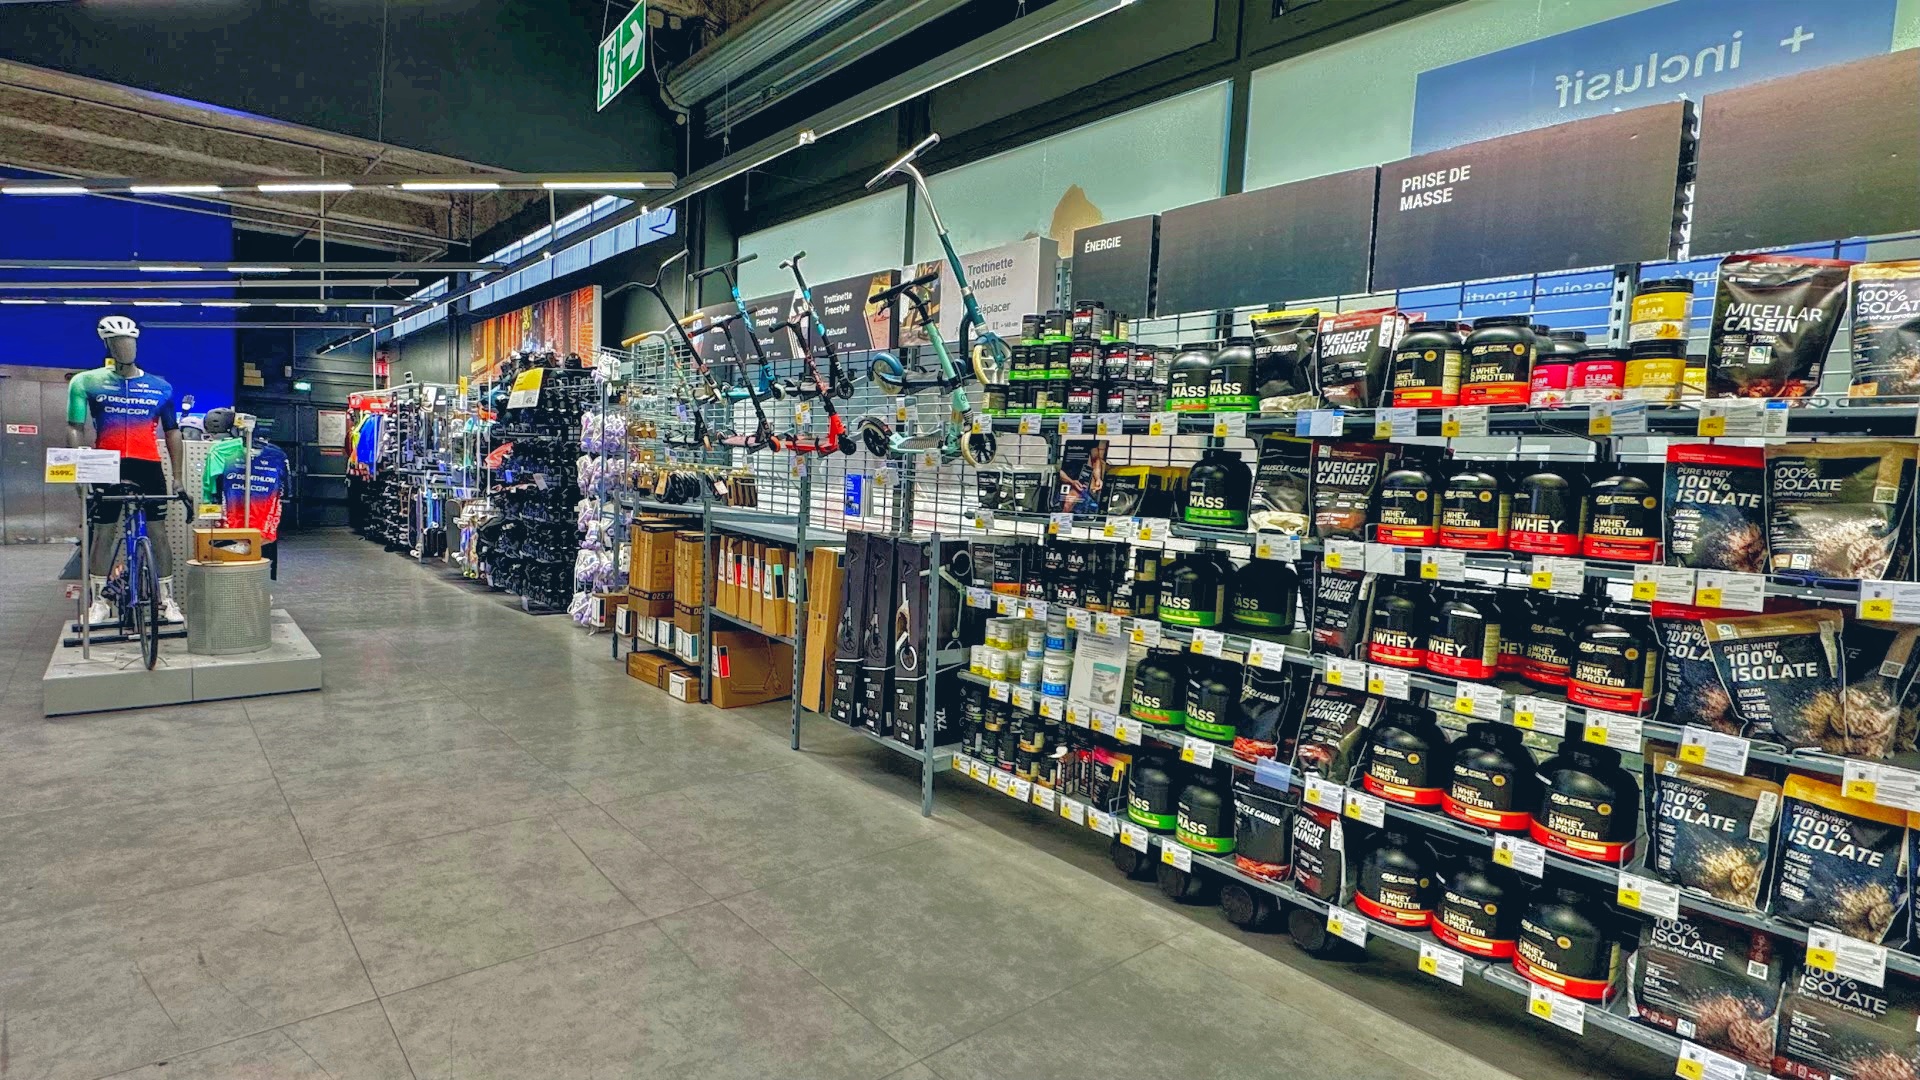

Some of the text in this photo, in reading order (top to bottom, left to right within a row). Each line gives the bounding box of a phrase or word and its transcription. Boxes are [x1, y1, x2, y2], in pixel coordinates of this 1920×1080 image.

[1401, 165, 1472, 194] PRISE DE
[1400, 187, 1454, 212] MASSE
[1084, 236, 1122, 254] ÉNERGIE
[968, 256, 1014, 277] Trottinette
[971, 273, 1007, 292] Mobilité
[823, 291, 853, 304] Trottinette
[1857, 289, 1908, 303] 100%
[824, 302, 851, 316] Freestyle
[1636, 305, 1665, 317] CLEAR
[1724, 301, 1823, 323] MICELLAR
[1722, 318, 1800, 333] CASEIN
[1321, 328, 1374, 347] WEIGHT
[1320, 340, 1367, 358] GAINER
[1476, 366, 1503, 374] WHEY
[1476, 373, 1515, 382] PROTEIN
[1585, 373, 1613, 382] CLEAR
[1171, 385, 1206, 399] MASS
[1209, 382, 1242, 396] MASS
[107, 396, 159, 407] DECATHLON
[1260, 464, 1311, 474] MUSCLE GAIN
[1317, 461, 1378, 475] WEIGHT
[1676, 467, 1732, 478] PURE WHEY
[1774, 467, 1817, 480] 100%
[1315, 473, 1371, 486] GAINER
[1677, 475, 1731, 492] 100%
[1773, 478, 1843, 492] ISOLATE
[1189, 496, 1225, 509] MASS
[1675, 489, 1763, 509] ISOLATE
[1384, 517, 1418, 525] PROTEIN
[1385, 510, 1406, 518] WHEY
[1446, 511, 1469, 519] WHEY
[1446, 519, 1480, 527] PROTEIN
[1514, 517, 1565, 534] WHEY
[1600, 519, 1630, 528] WHEY
[1599, 527, 1644, 537] PROTEIN
[1319, 575, 1358, 593] WEIGHT
[1057, 589, 1077, 600] EAA
[1160, 594, 1191, 610] MASS
[1318, 587, 1352, 603] GAINER
[1375, 632, 1418, 649] WHEY
[1428, 638, 1467, 658] WHEY
[1723, 641, 1781, 653] PURE WHEY
[1531, 645, 1557, 656] WHEY
[1531, 652, 1569, 665] PROTEIN
[1726, 649, 1784, 666] 100%
[1582, 665, 1612, 678] WHEY
[1730, 662, 1818, 683] ISOLATE
[1581, 673, 1626, 688] PROTEIN
[1131, 692, 1161, 709] MASS
[1310, 698, 1358, 715] WEIGHT
[1186, 704, 1216, 723] MASS
[1306, 708, 1350, 725] GAINER
[1376, 765, 1398, 776] WHEY
[1375, 772, 1409, 786] PROTEIN
[1457, 786, 1482, 797] WHEY
[1660, 780, 1710, 799] PURE WHEY
[1457, 793, 1494, 809] PROTEIN
[1661, 788, 1707, 812] 100%
[1254, 809, 1281, 828] GAINER
[1556, 815, 1586, 830] WHEY
[1659, 802, 1738, 833] ISOLATE
[1793, 804, 1853, 828] PURE WHEY
[1177, 814, 1208, 836] MASS
[1555, 824, 1599, 840] PROTEIN
[1791, 813, 1852, 843] 100%
[1294, 828, 1324, 851] AINER
[1787, 827, 1885, 868] ISOLATE
[1386, 891, 1412, 903] WHEY
[1386, 899, 1420, 910] PROTEIN
[1449, 912, 1474, 927] WHEY
[1449, 918, 1486, 937] PROTEIN
[1522, 940, 1546, 958] WHEY
[1651, 926, 1726, 961] ISOLATE
[1521, 949, 1558, 972] PROTEIN
[1650, 940, 1717, 967] Pure whey protein
[1800, 973, 1888, 1017] ISOLATE
[1797, 987, 1877, 1021] Pure whey protein
